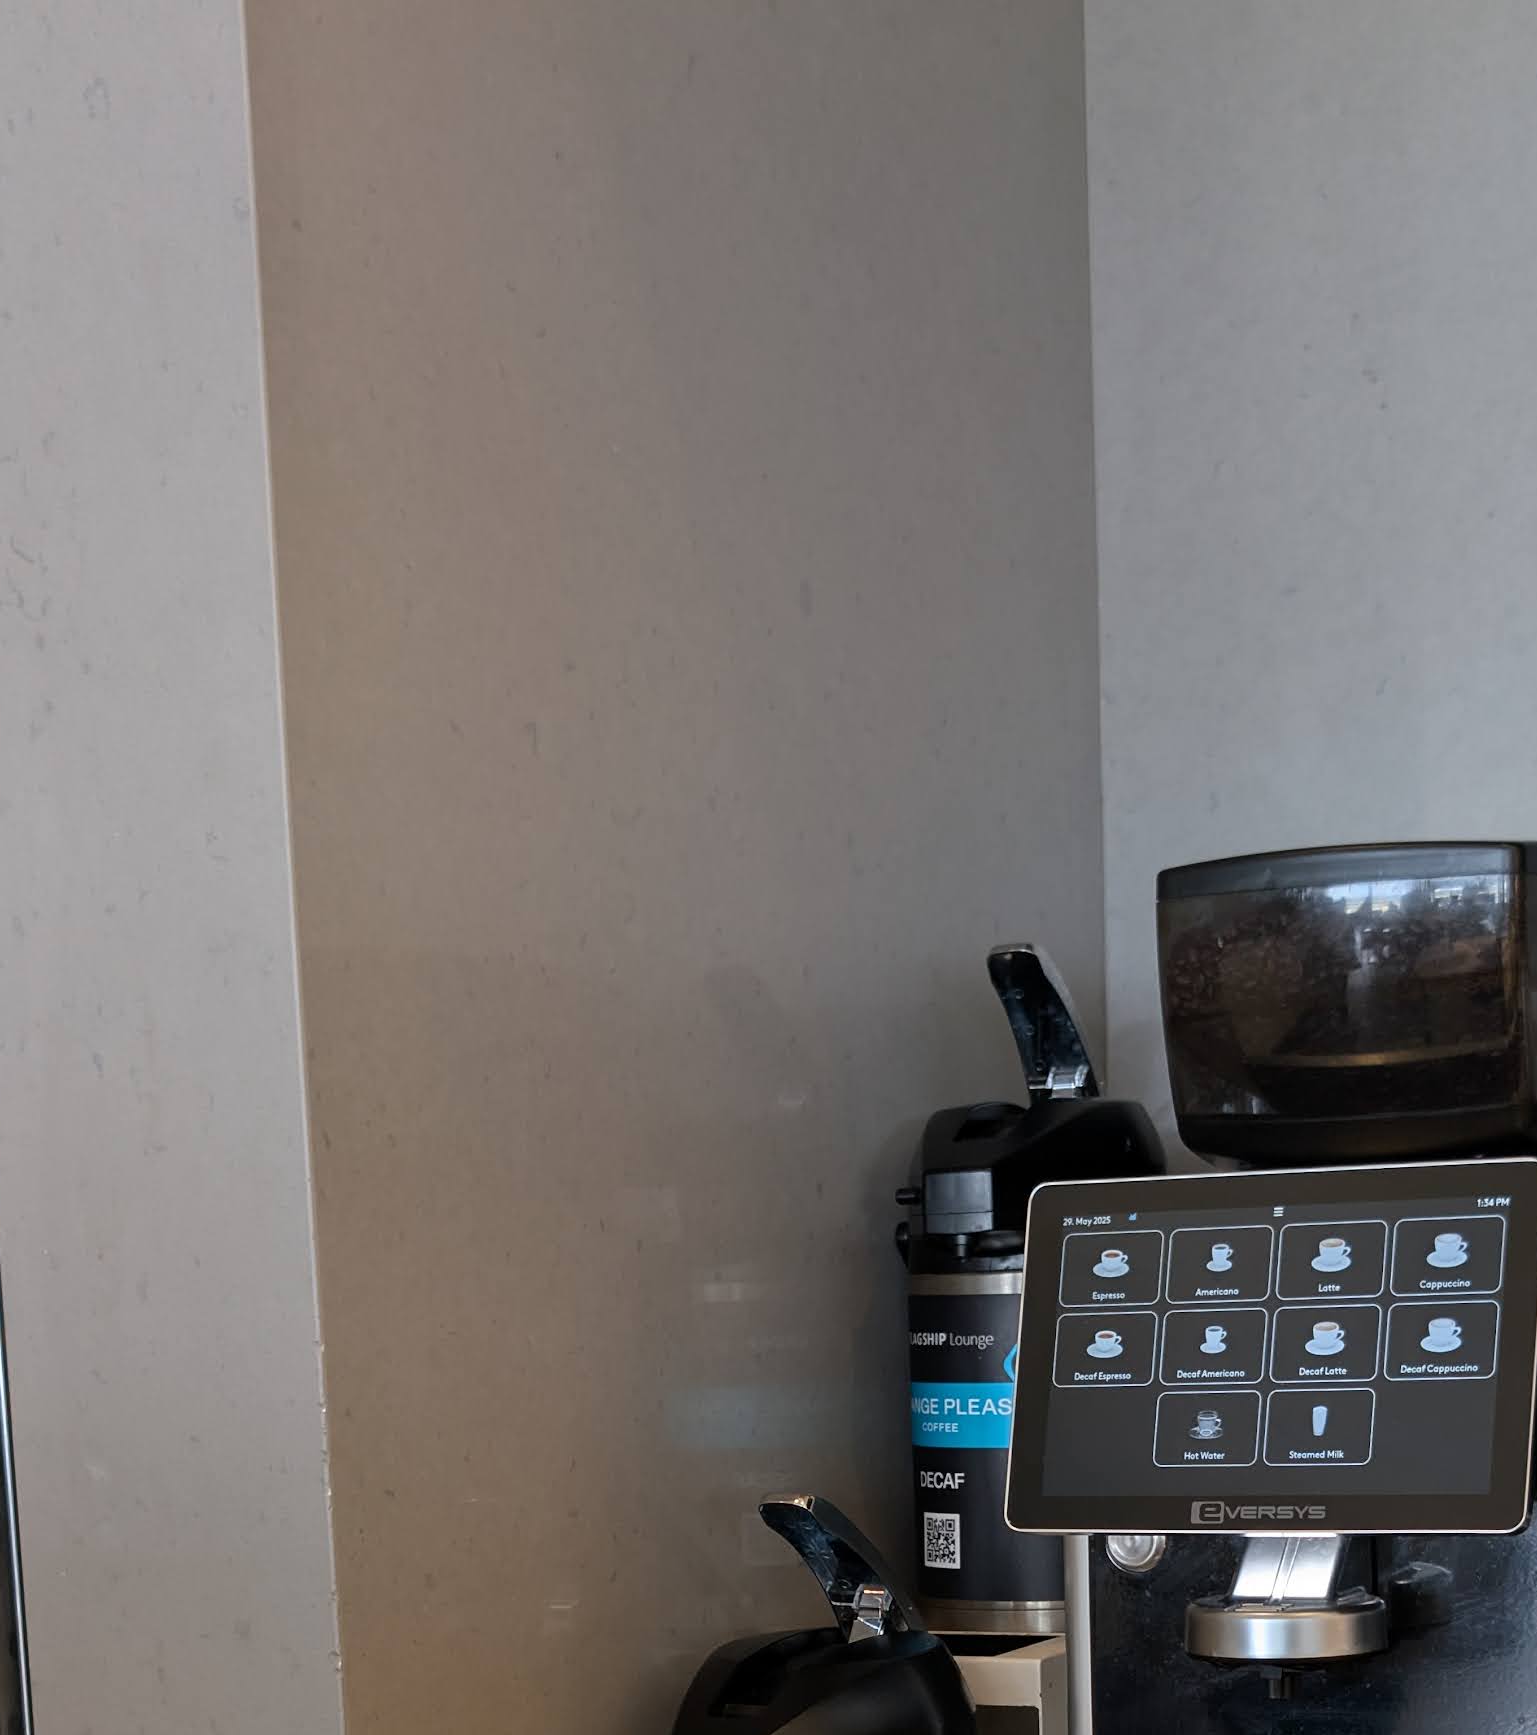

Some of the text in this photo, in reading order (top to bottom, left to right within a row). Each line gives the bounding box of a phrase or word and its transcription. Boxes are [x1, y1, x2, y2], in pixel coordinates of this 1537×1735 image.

[1476, 1197, 1511, 1208] 1:34 PM
[1075, 1216, 1093, 1228] May
[1093, 1215, 1112, 1225] 2025
[1318, 1282, 1341, 1293] Latte
[1419, 1279, 1471, 1290] Cappuccino
[1092, 1291, 1126, 1301] Espresso
[1195, 1286, 1240, 1297] Americano
[949, 1332, 995, 1350] Lounge
[1176, 1368, 1245, 1379] Decaf Americano
[1298, 1366, 1347, 1376] Decaf Latte
[1400, 1363, 1479, 1375] Decaf Cappuccino
[1074, 1371, 1132, 1382] Decaf Espresso
[922, 1422, 959, 1433] COFFEE
[1184, 1450, 1225, 1460] Hot Water
[1289, 1449, 1345, 1460] Steamed Milk
[920, 1471, 965, 1490] DECAF
